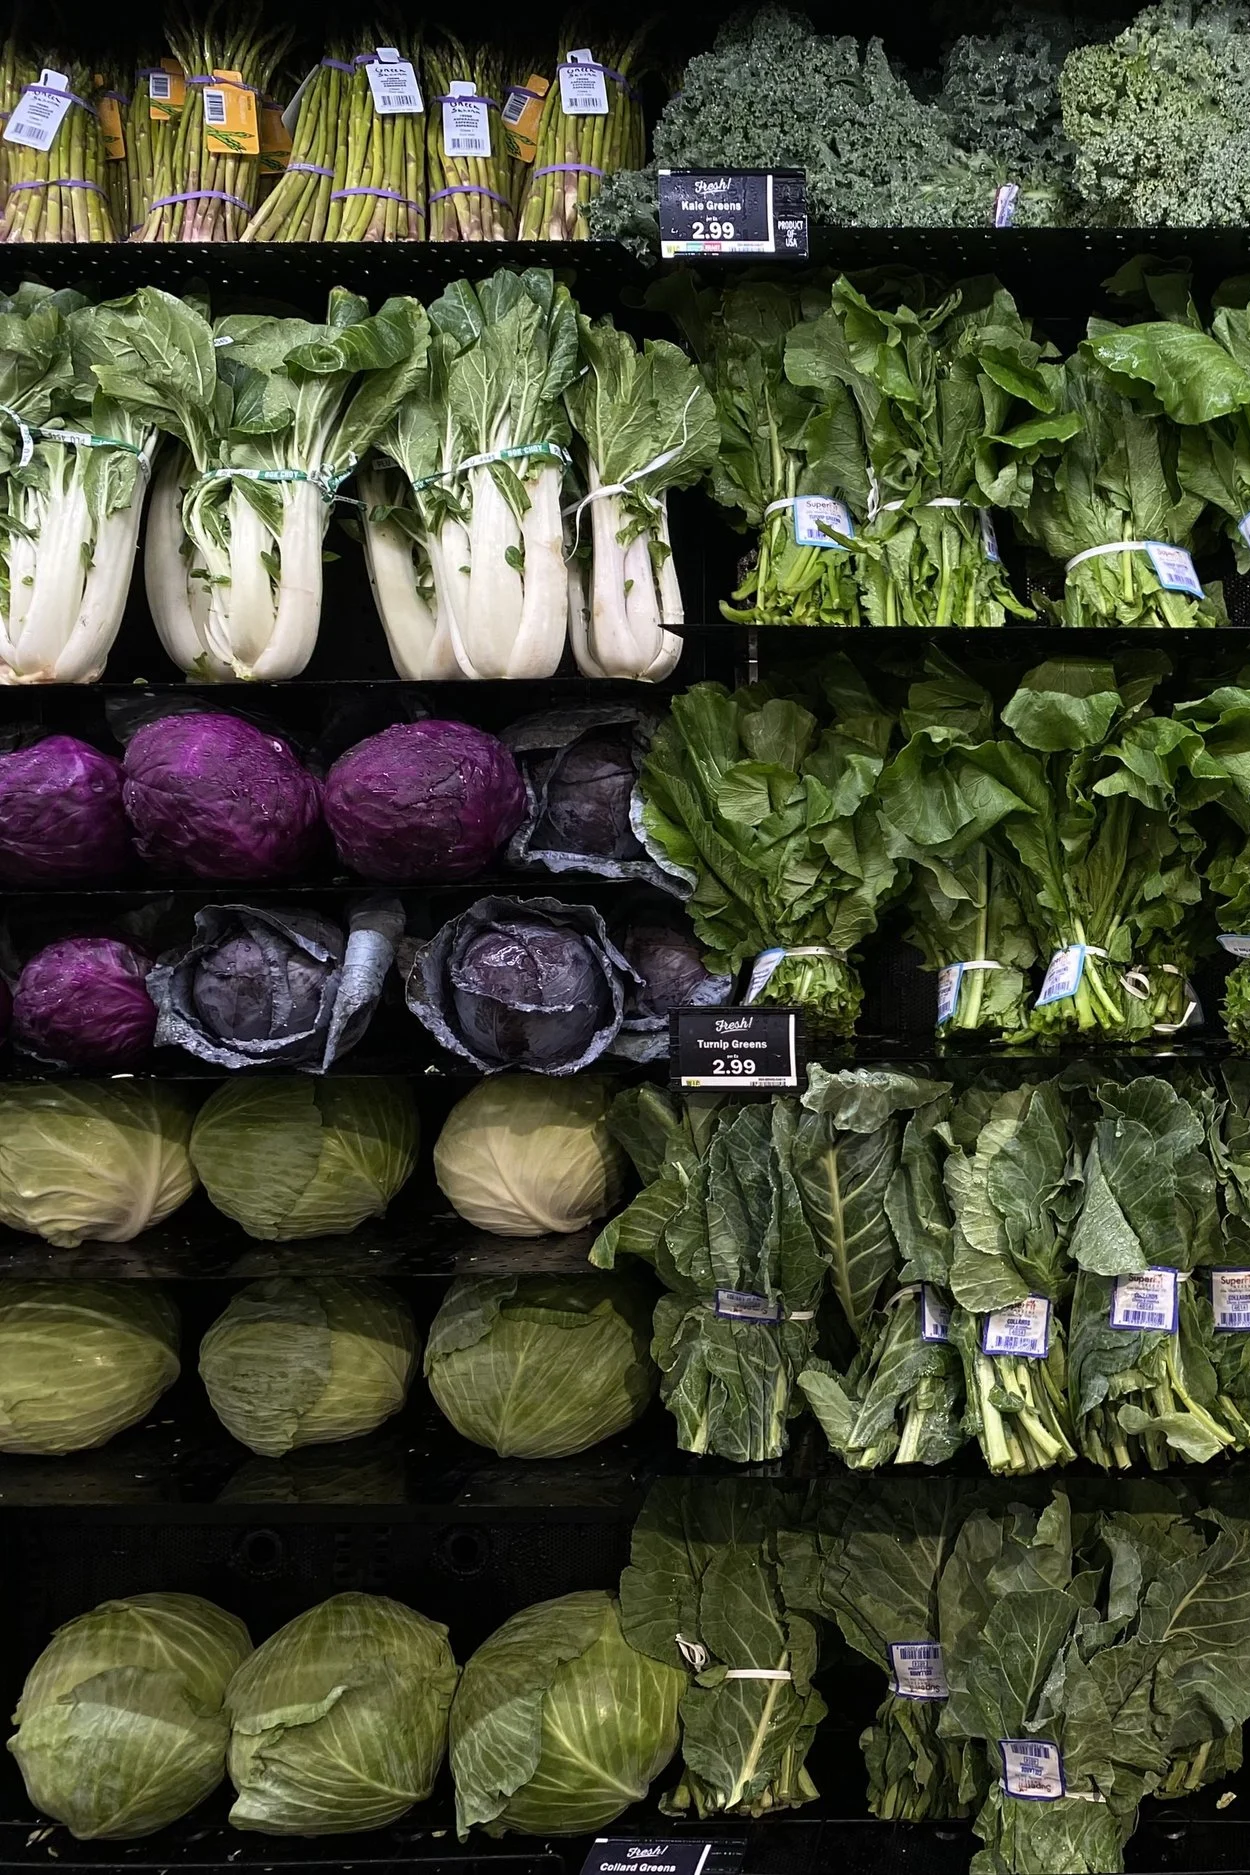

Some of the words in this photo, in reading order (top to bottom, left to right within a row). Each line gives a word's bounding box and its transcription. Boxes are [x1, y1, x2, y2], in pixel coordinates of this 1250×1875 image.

[694, 178, 731, 194] Fresh!
[682, 201, 704, 210] Kale
[706, 201, 741, 210] Greens
[692, 222, 734, 239] 2.99
[778, 221, 803, 230] PRODUCT
[787, 230, 796, 238] OF
[785, 239, 797, 247] USA
[715, 1017, 753, 1034] Fresh!
[697, 1040, 729, 1050] Turnip
[732, 1040, 767, 1048] Greens
[712, 1059, 756, 1075] 2.99
[627, 1845, 668, 1859] Fresh!
[600, 1863, 636, 1872] Collard
[639, 1863, 676, 1872] Greens
